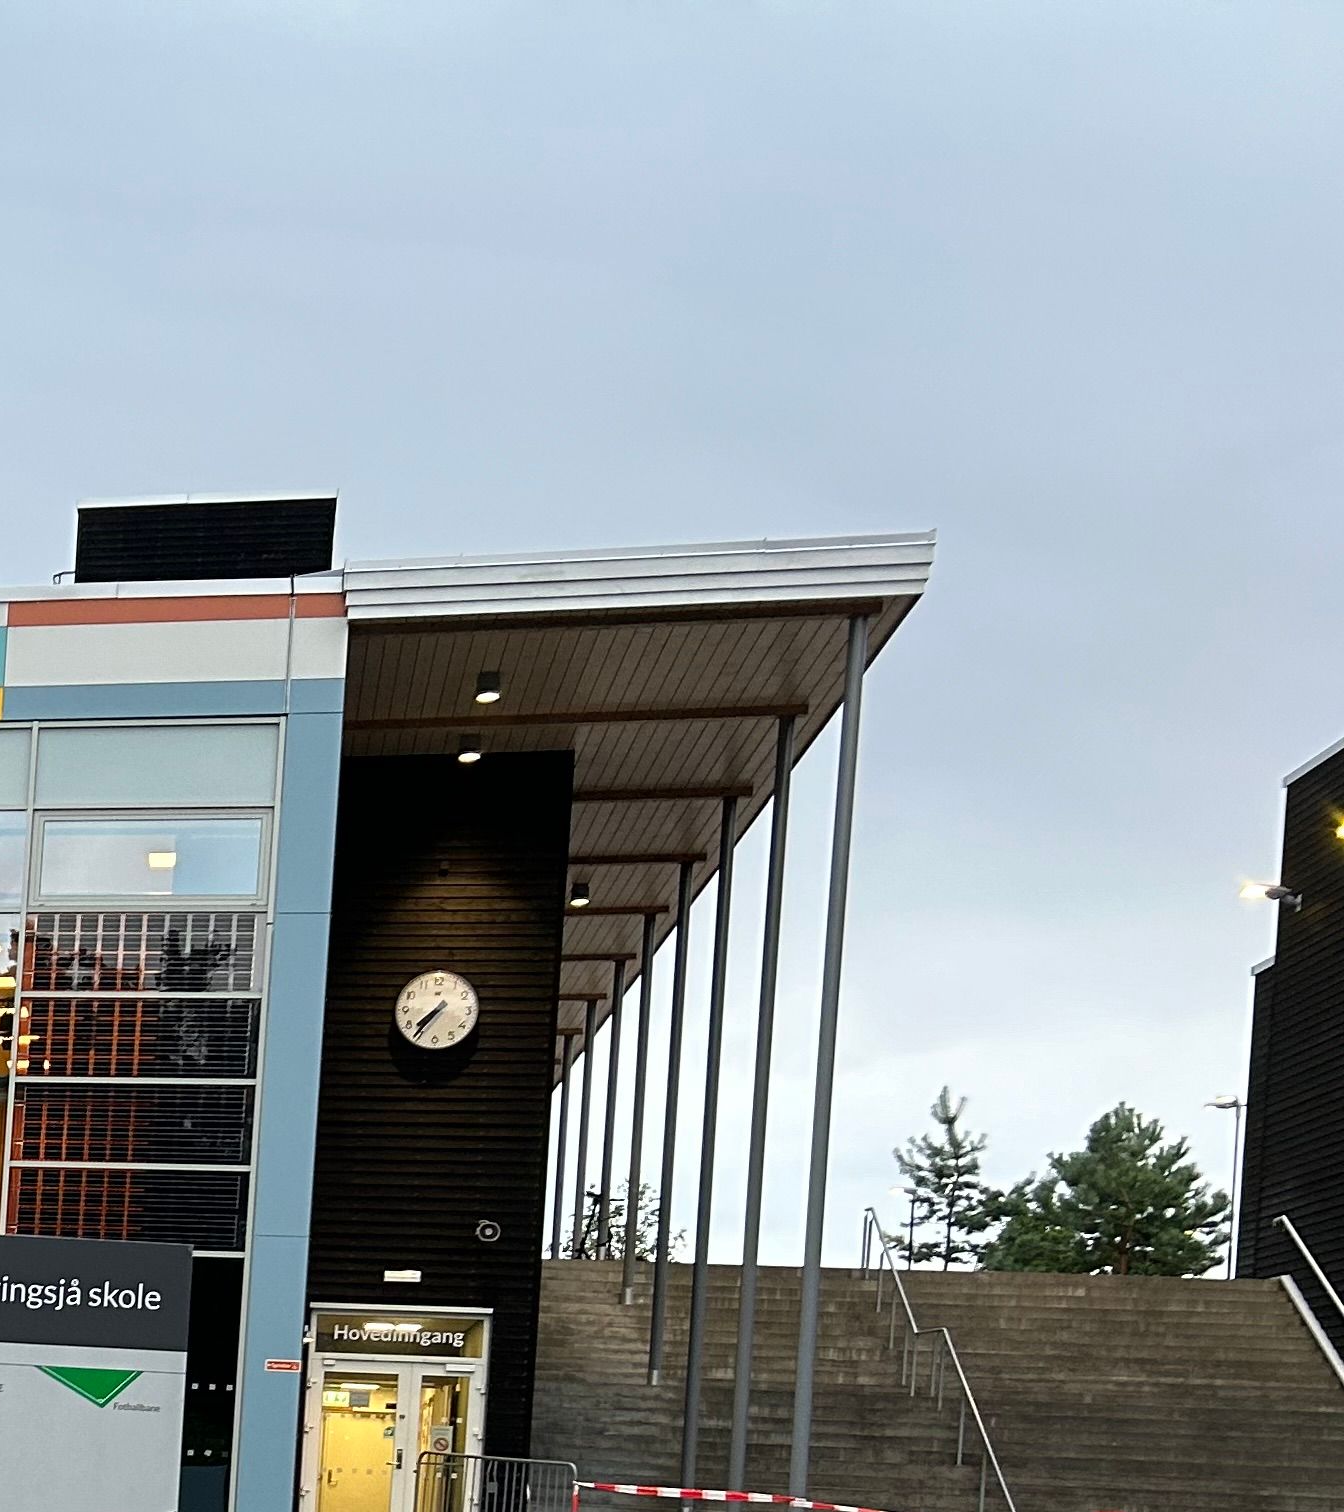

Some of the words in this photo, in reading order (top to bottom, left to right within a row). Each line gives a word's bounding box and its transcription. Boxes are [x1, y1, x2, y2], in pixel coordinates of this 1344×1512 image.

[434, 977, 445, 986] 12
[406, 991, 416, 1000] 10
[461, 990, 469, 1000] 2
[402, 1005, 410, 1015] 9
[465, 1005, 473, 1016] 3
[405, 1020, 412, 1030] 8
[458, 1020, 467, 1029] 4
[431, 1035, 439, 1044] 6
[447, 1031, 455, 1041] 5
[88, 1280, 162, 1310] skole
[333, 1324, 465, 1347] Hovedinngang
